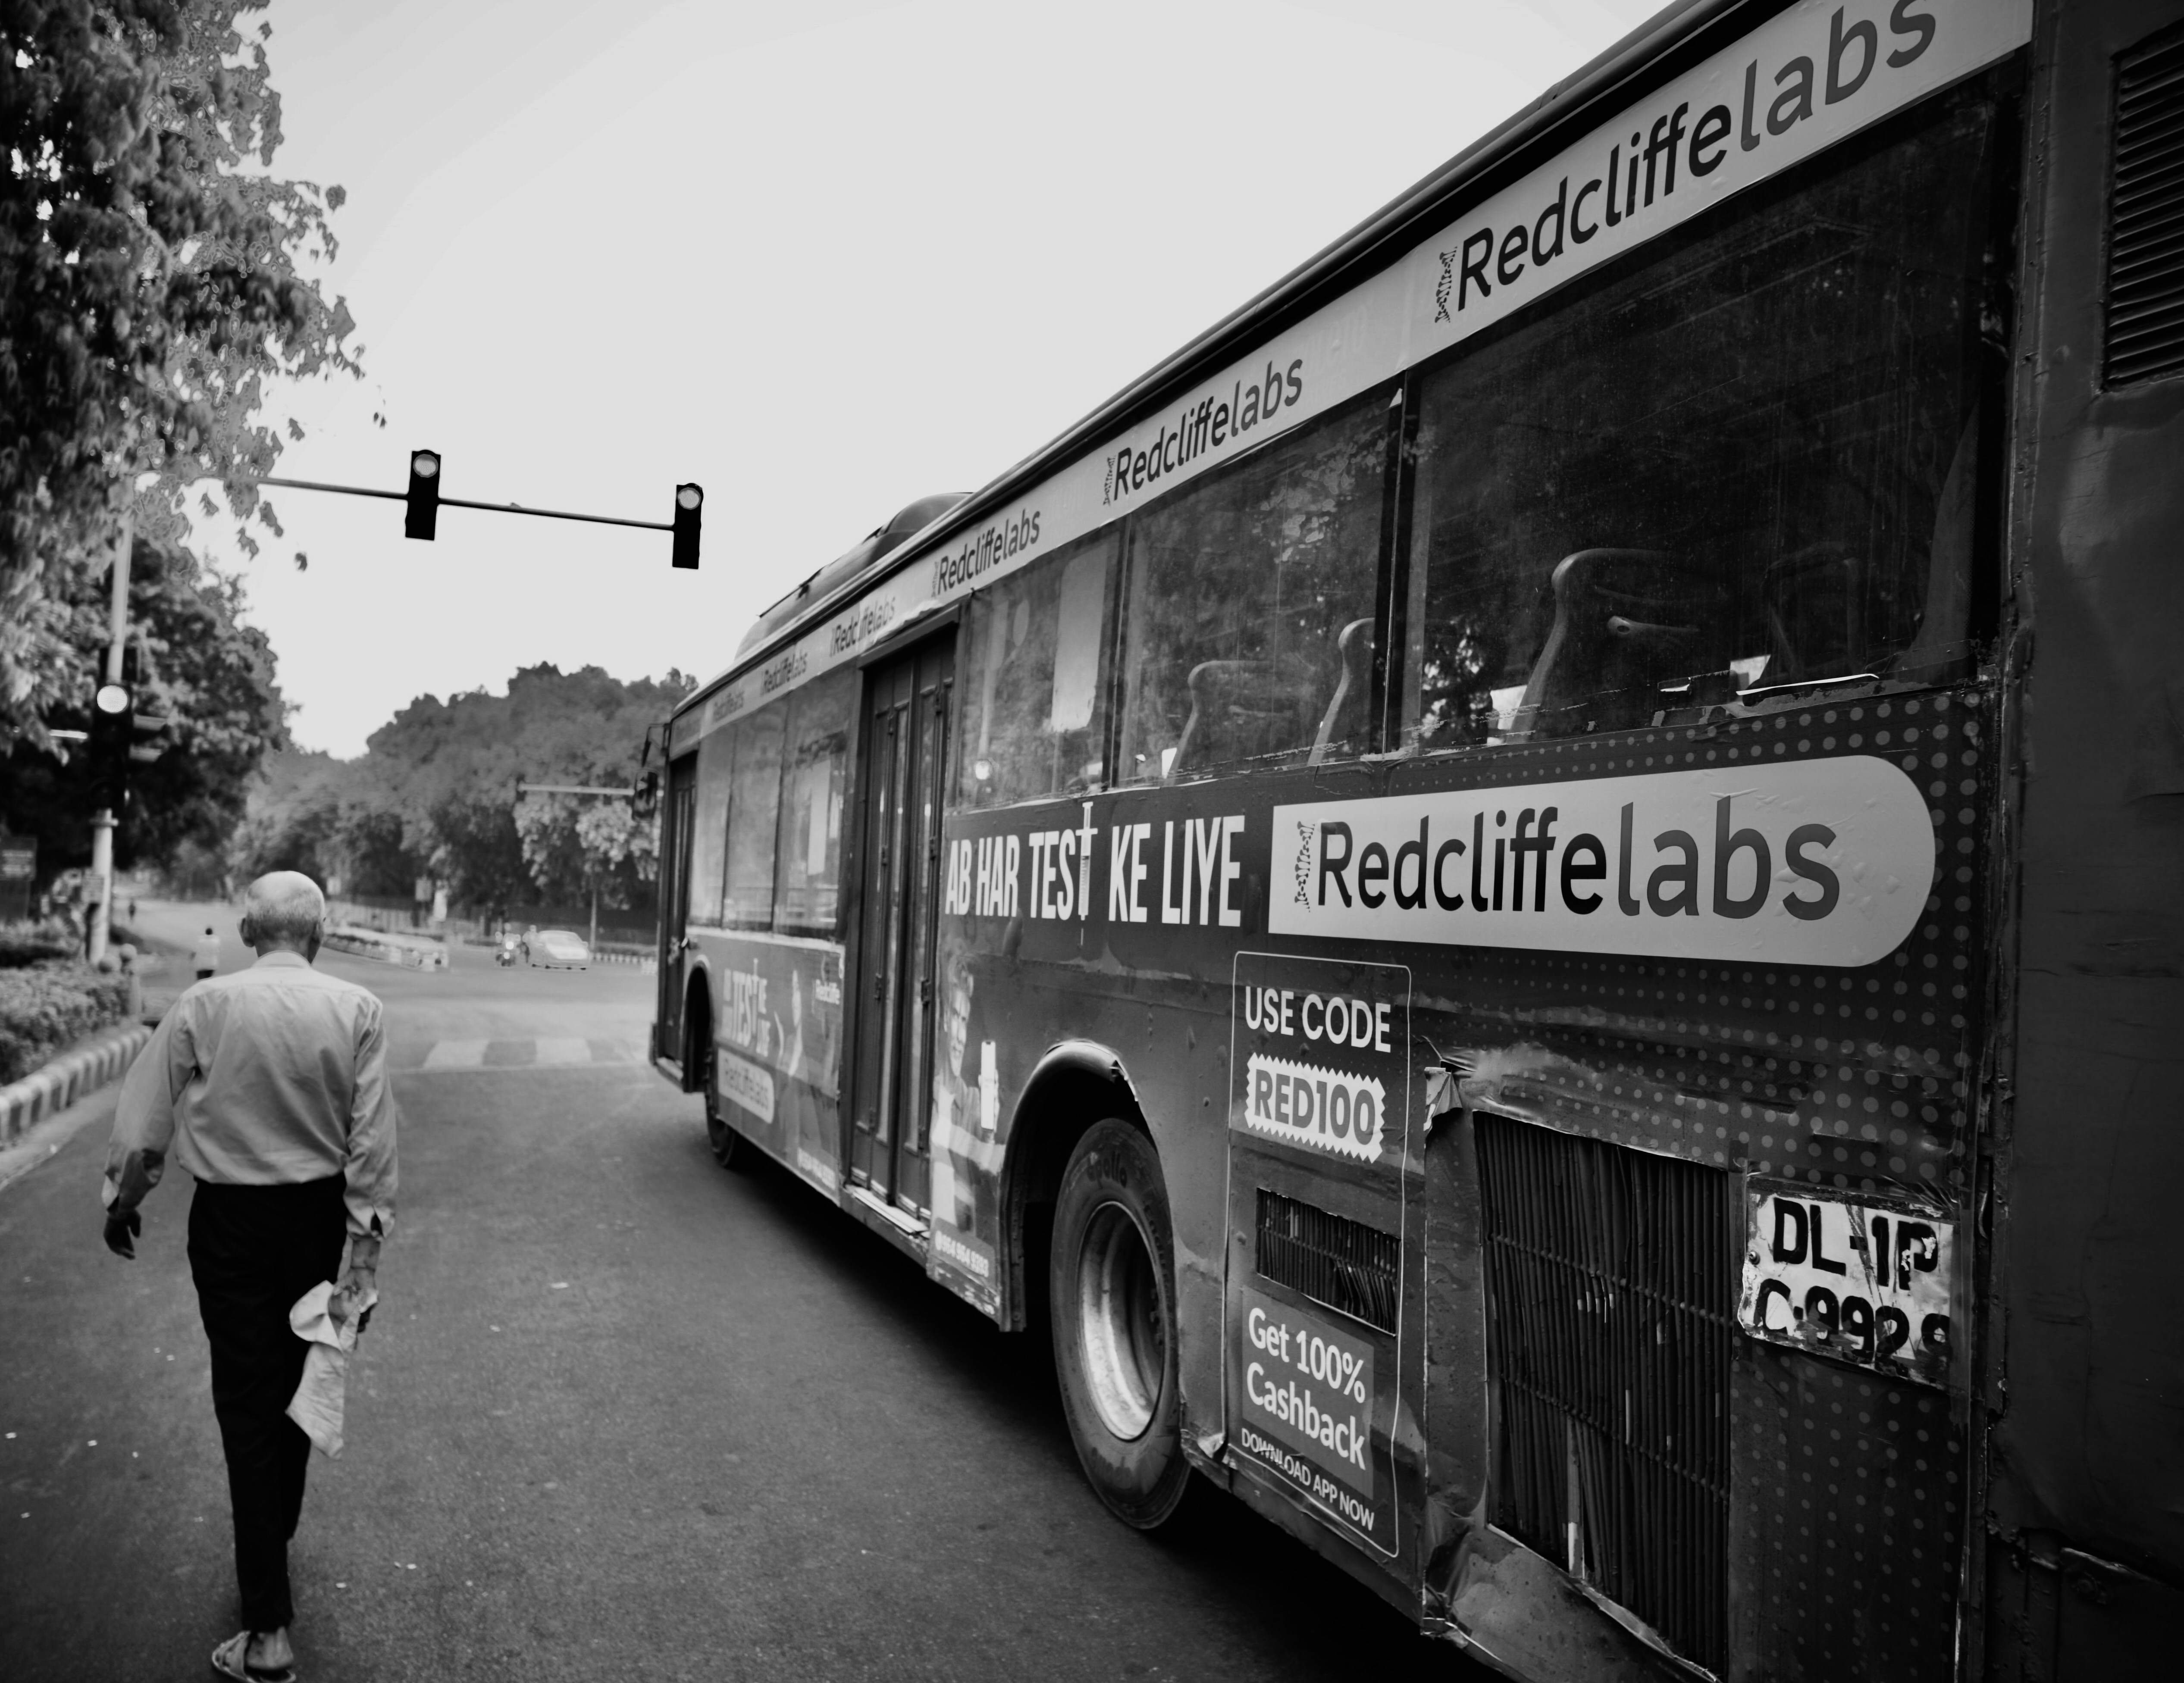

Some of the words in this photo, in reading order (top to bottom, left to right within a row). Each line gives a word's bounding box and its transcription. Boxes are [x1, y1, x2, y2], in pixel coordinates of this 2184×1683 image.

[1457, 0, 1936, 311] Redcliffelabs
[1114, 359, 1303, 501] Redcliffelabs
[937, 508, 1040, 595] Redcliffelabs
[944, 839, 972, 916] AB
[976, 835, 1020, 917] HAR
[1029, 802, 1098, 921] TEST
[1109, 823, 1151, 923] KE
[1161, 815, 1245, 927] LIYE
[1318, 795, 1840, 921] Redcliffelabs
[1245, 985, 1294, 1036] USE
[1302, 993, 1391, 1053] CODE
[1254, 1068, 1376, 1145] RED100
[1248, 1307, 1290, 1363] Get
[1296, 1330, 1365, 1404] 100%
[1246, 1361, 1366, 1470] Cashback
[1241, 1427, 1311, 1486] DOWNLOAD
[1313, 1474, 1337, 1503] APP
[1340, 1490, 1375, 1531] NOW
